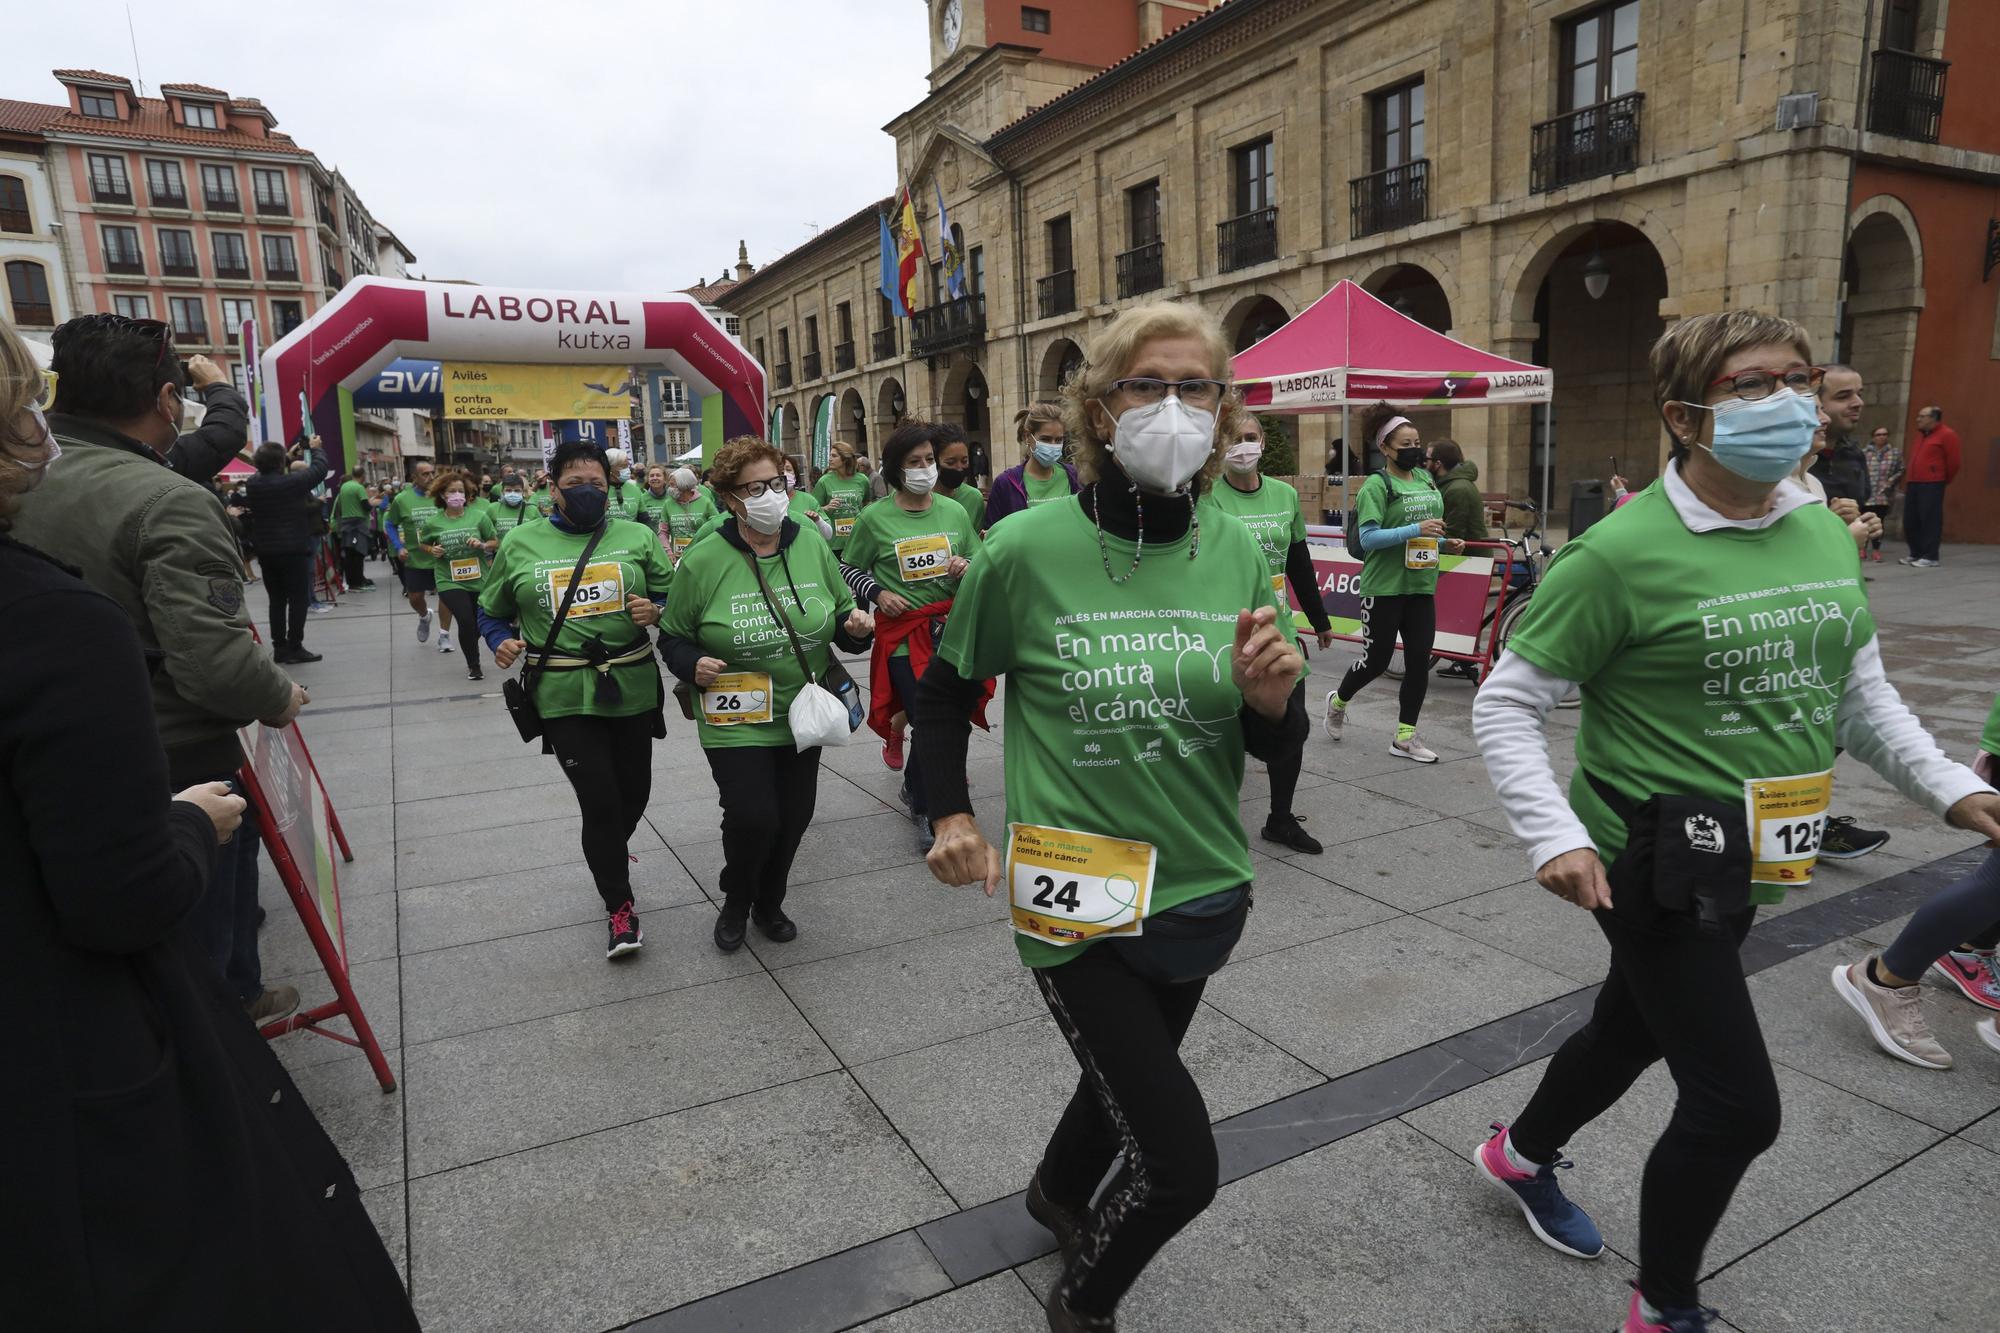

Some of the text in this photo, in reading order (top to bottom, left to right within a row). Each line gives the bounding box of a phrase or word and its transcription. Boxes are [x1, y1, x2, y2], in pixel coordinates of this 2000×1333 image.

[443, 291, 631, 325] LABORAL
[312, 316, 375, 366] banka kooperatiboa
[558, 329, 631, 350] kutxa
[691, 331, 739, 375] banca cooperativa
[377, 365, 444, 394] avi
[452, 370, 488, 381] Avilés
[1278, 374, 1337, 393] LABORAL
[1494, 374, 1545, 388] LABORAL
[454, 394, 492, 404] contra
[1311, 390, 1337, 402] kutxa
[455, 405, 509, 415] el cáncer
[1402, 496, 1413, 504] En
[907, 554, 935, 569] 368
[1415, 551, 1429, 561] 45
[456, 567, 472, 575] 287
[1315, 571, 1361, 596] LABO
[538, 593, 551, 608] el
[571, 585, 601, 604] 05
[1696, 595, 1735, 610] AVILÉS
[1735, 592, 1750, 602] EN
[1749, 586, 1792, 599] MARCHA
[1792, 581, 1827, 592] CONTRA
[731, 601, 749, 615] En
[1055, 609, 1239, 626] AVILÉS EN MARCHA CONTRA EL CÁNCE
[732, 613, 776, 629] contra
[1702, 597, 1842, 639] En marcha
[733, 625, 791, 645] el cánce
[1055, 625, 1207, 660] En marcha
[1704, 636, 1796, 670] contra
[1062, 660, 1154, 692] contra
[1702, 668, 1822, 696] el cáncer
[716, 695, 742, 711] 26
[1068, 692, 1189, 723] el cáncer
[1720, 711, 1742, 723] edp
[1704, 725, 1760, 737] fundación
[1084, 742, 1101, 755] edp
[1072, 757, 1120, 767] fundación
[1759, 801, 1789, 810] contra
[1790, 800, 1799, 808] el
[1017, 834, 1094, 854] Avilés en marcha
[1775, 819, 1821, 855] 125
[1016, 846, 1089, 865] contra el cáncer
[1032, 874, 1081, 913] 24
